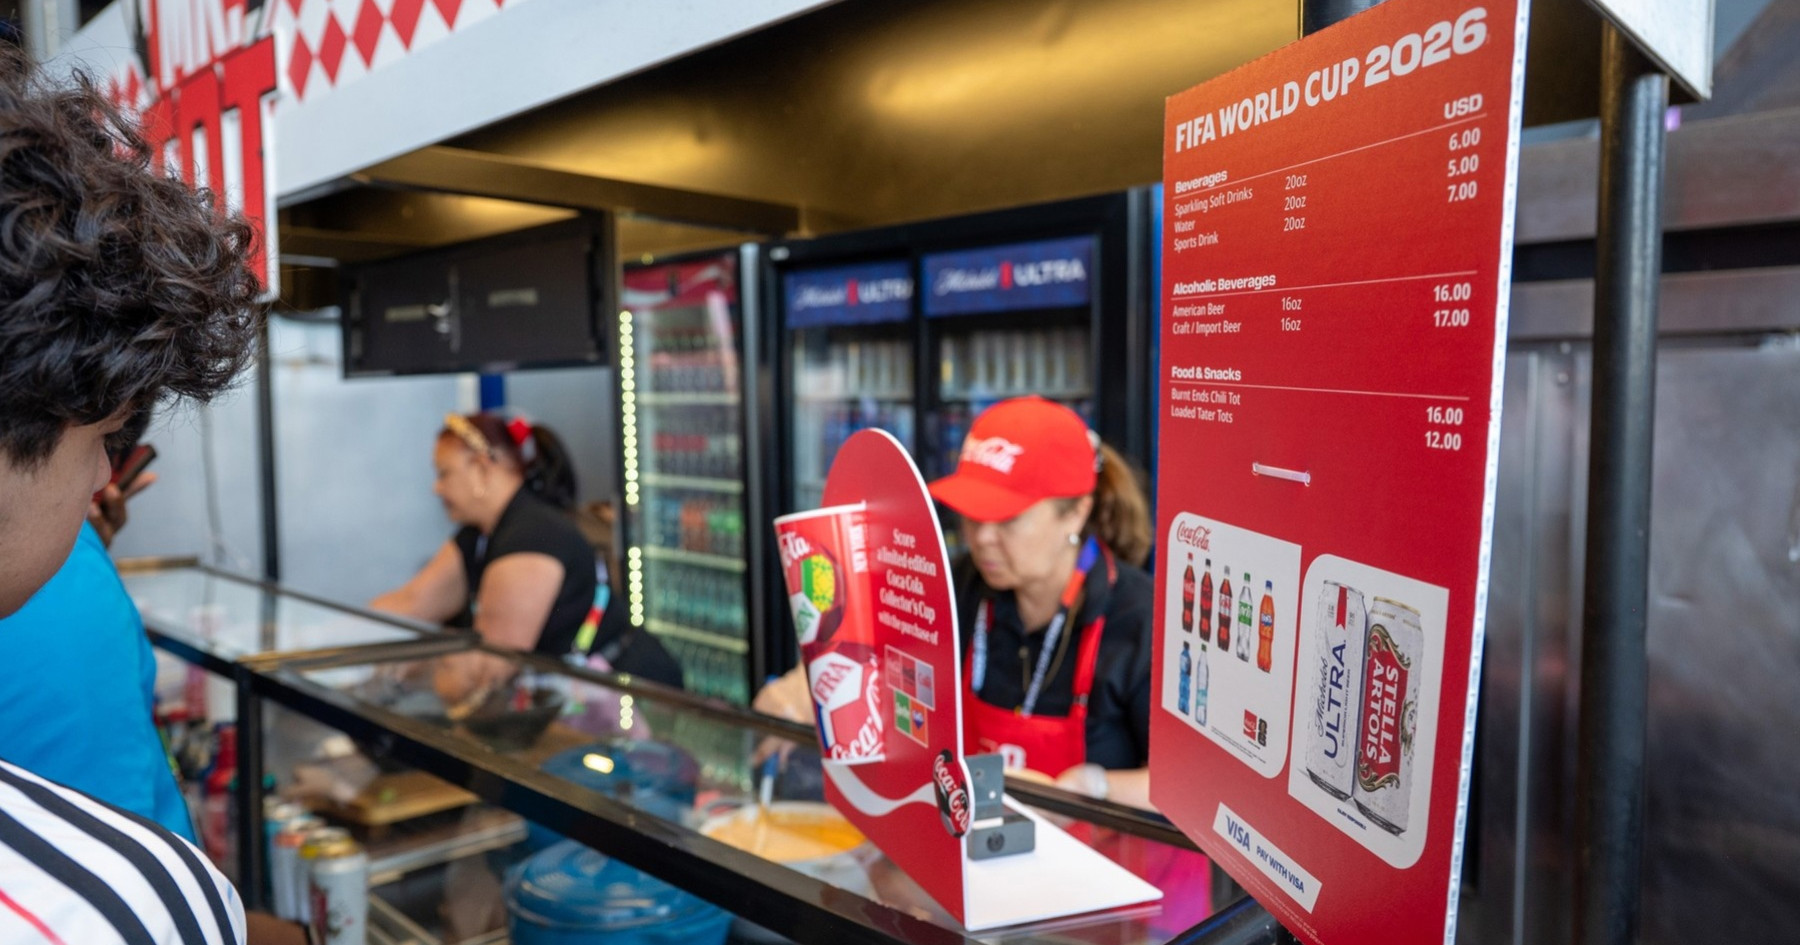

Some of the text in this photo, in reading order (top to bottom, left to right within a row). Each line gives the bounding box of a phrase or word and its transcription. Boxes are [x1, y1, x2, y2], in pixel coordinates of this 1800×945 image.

[1174, 7, 1488, 153] FIFA WORLD CUP 2026
[1443, 93, 1484, 120] USD
[1448, 127, 1481, 152] 6.00
[1447, 154, 1479, 178] 5.00
[1174, 170, 1228, 194] Beverages
[1447, 180, 1477, 204] 7.00
[1174, 174, 1307, 218] Sparkling Soft Drinks 20oz
[1174, 195, 1307, 234] Water 20oz
[1173, 216, 1306, 254] Sports Drink 20oz
[1172, 274, 1277, 296] Alcoholic Beverages
[1433, 283, 1471, 303] 16.00
[1172, 296, 1302, 318] American Beer 16oz
[1433, 309, 1470, 328] 17.00
[1172, 321, 1190, 335] Craft
[1196, 321, 1222, 337] Import
[1223, 320, 1242, 333] Beer
[1280, 317, 1302, 332] 16oz
[1171, 366, 1242, 381] Food & Snacks
[1171, 387, 1241, 405] Burnt Ends Chili Tot
[1171, 404, 1233, 423] Loaded Tater Tots
[1426, 406, 1464, 425] 16.00
[1424, 431, 1462, 450] 12.00
[892, 527, 916, 549] Score
[814, 661, 854, 704] FRA
[1323, 642, 1347, 759] ULTRA
[1366, 658, 1385, 760] ARTOIS
[1378, 665, 1399, 764] STELLA
[1226, 813, 1250, 851] VISA
[1256, 845, 1269, 862] PAY
[1269, 855, 1288, 879] WITH
[1288, 871, 1305, 894] VISA
